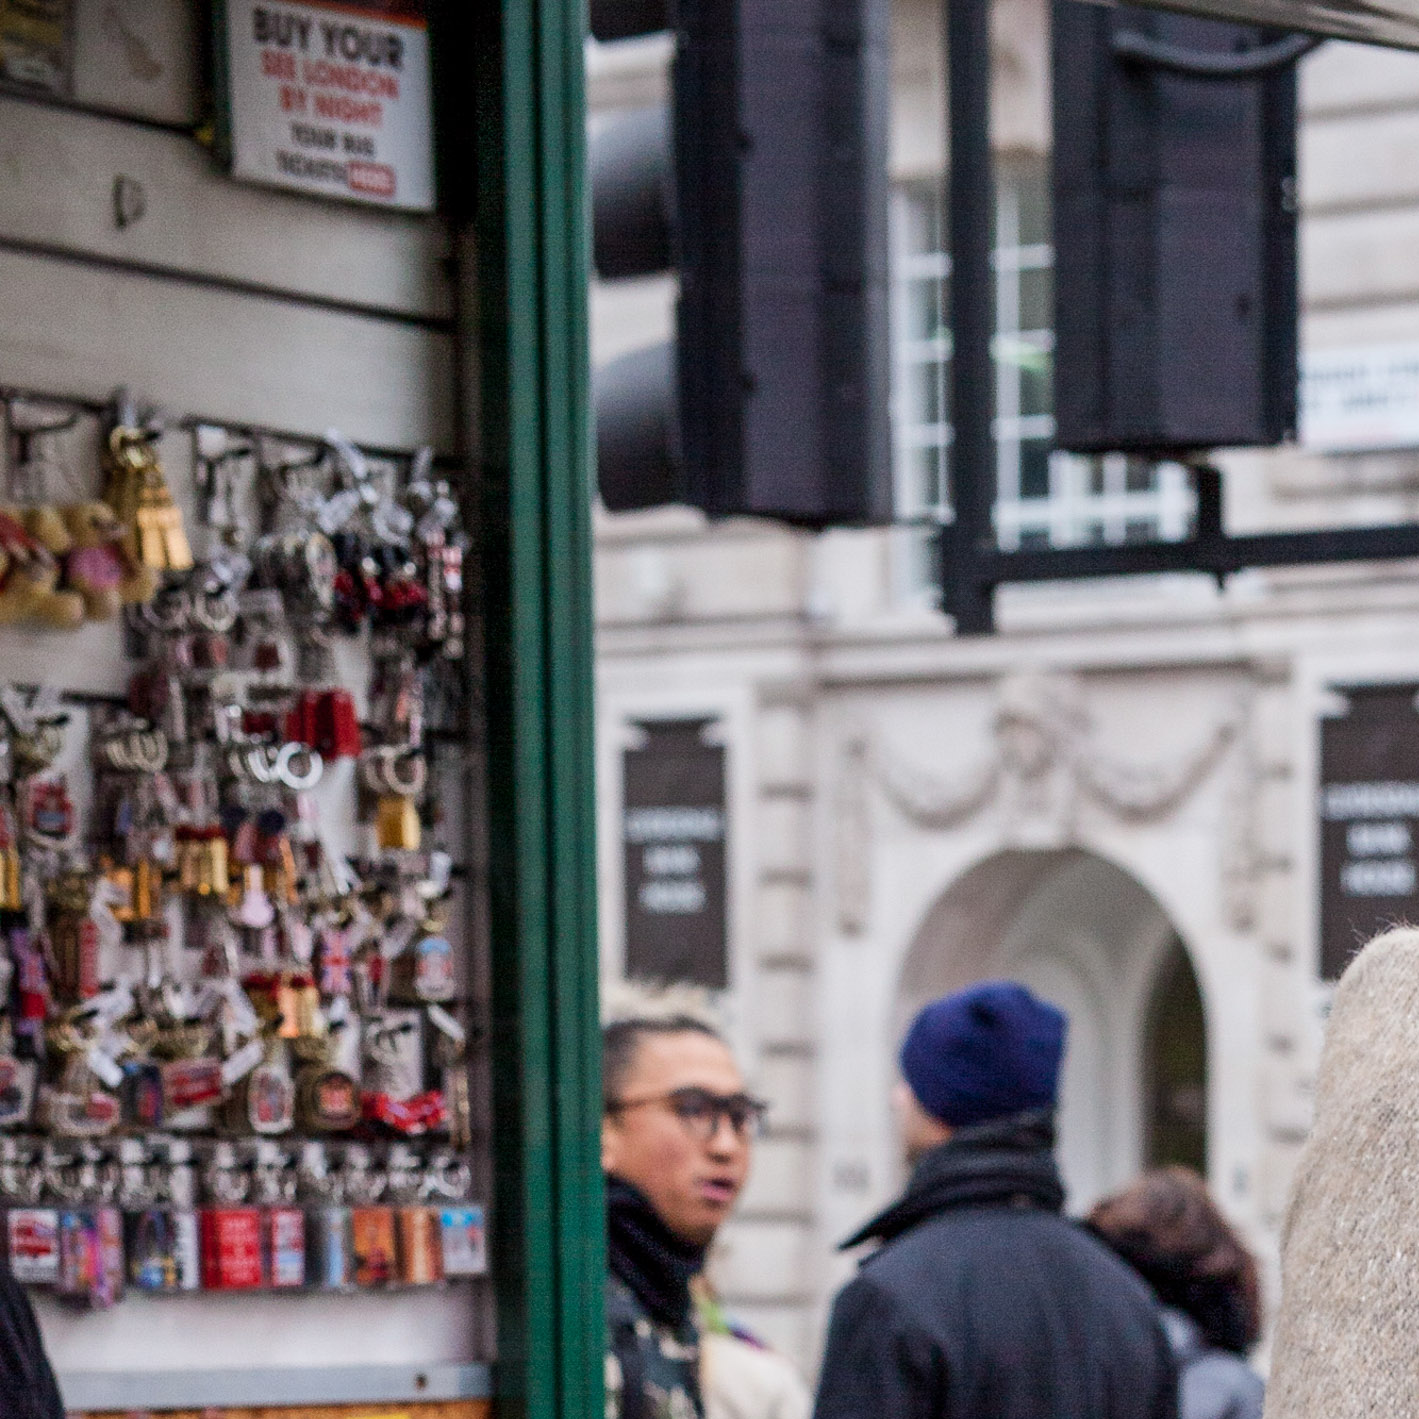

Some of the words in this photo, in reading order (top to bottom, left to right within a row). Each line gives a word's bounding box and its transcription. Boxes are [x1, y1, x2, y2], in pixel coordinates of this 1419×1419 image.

[253, 6, 312, 52] BUY
[319, 19, 404, 71] YOUR
[302, 58, 401, 100] LONDON
